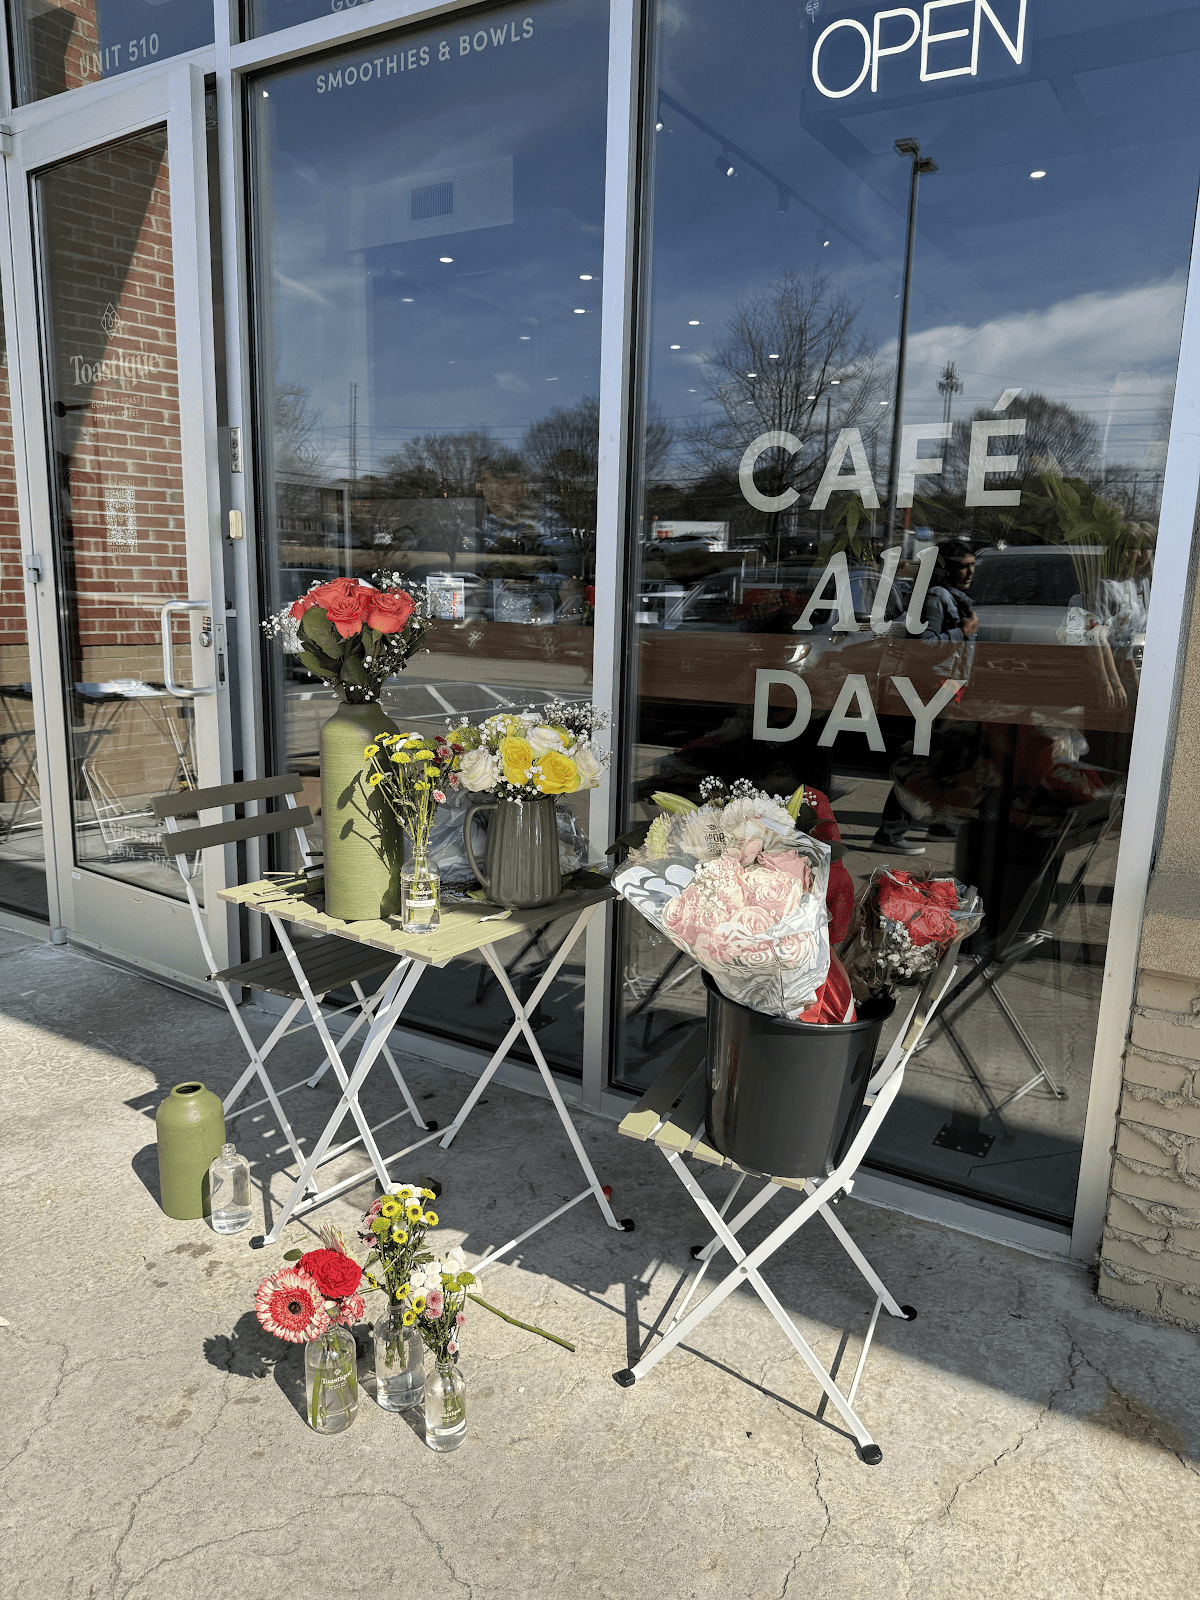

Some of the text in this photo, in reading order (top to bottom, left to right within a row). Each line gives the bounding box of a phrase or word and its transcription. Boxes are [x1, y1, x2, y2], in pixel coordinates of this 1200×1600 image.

[80, 33, 159, 77] UNIT 510
[316, 17, 534, 93] SMOOTHIES & BOWLS
[812, 0, 1027, 98] OPEN
[69, 353, 159, 387] Toastique
[121, 396, 140, 405] TOAST
[738, 388, 1027, 512] CAFÉ
[792, 546, 939, 635] All
[752, 668, 968, 757] DAY
[109, 821, 138, 838] OPEN
